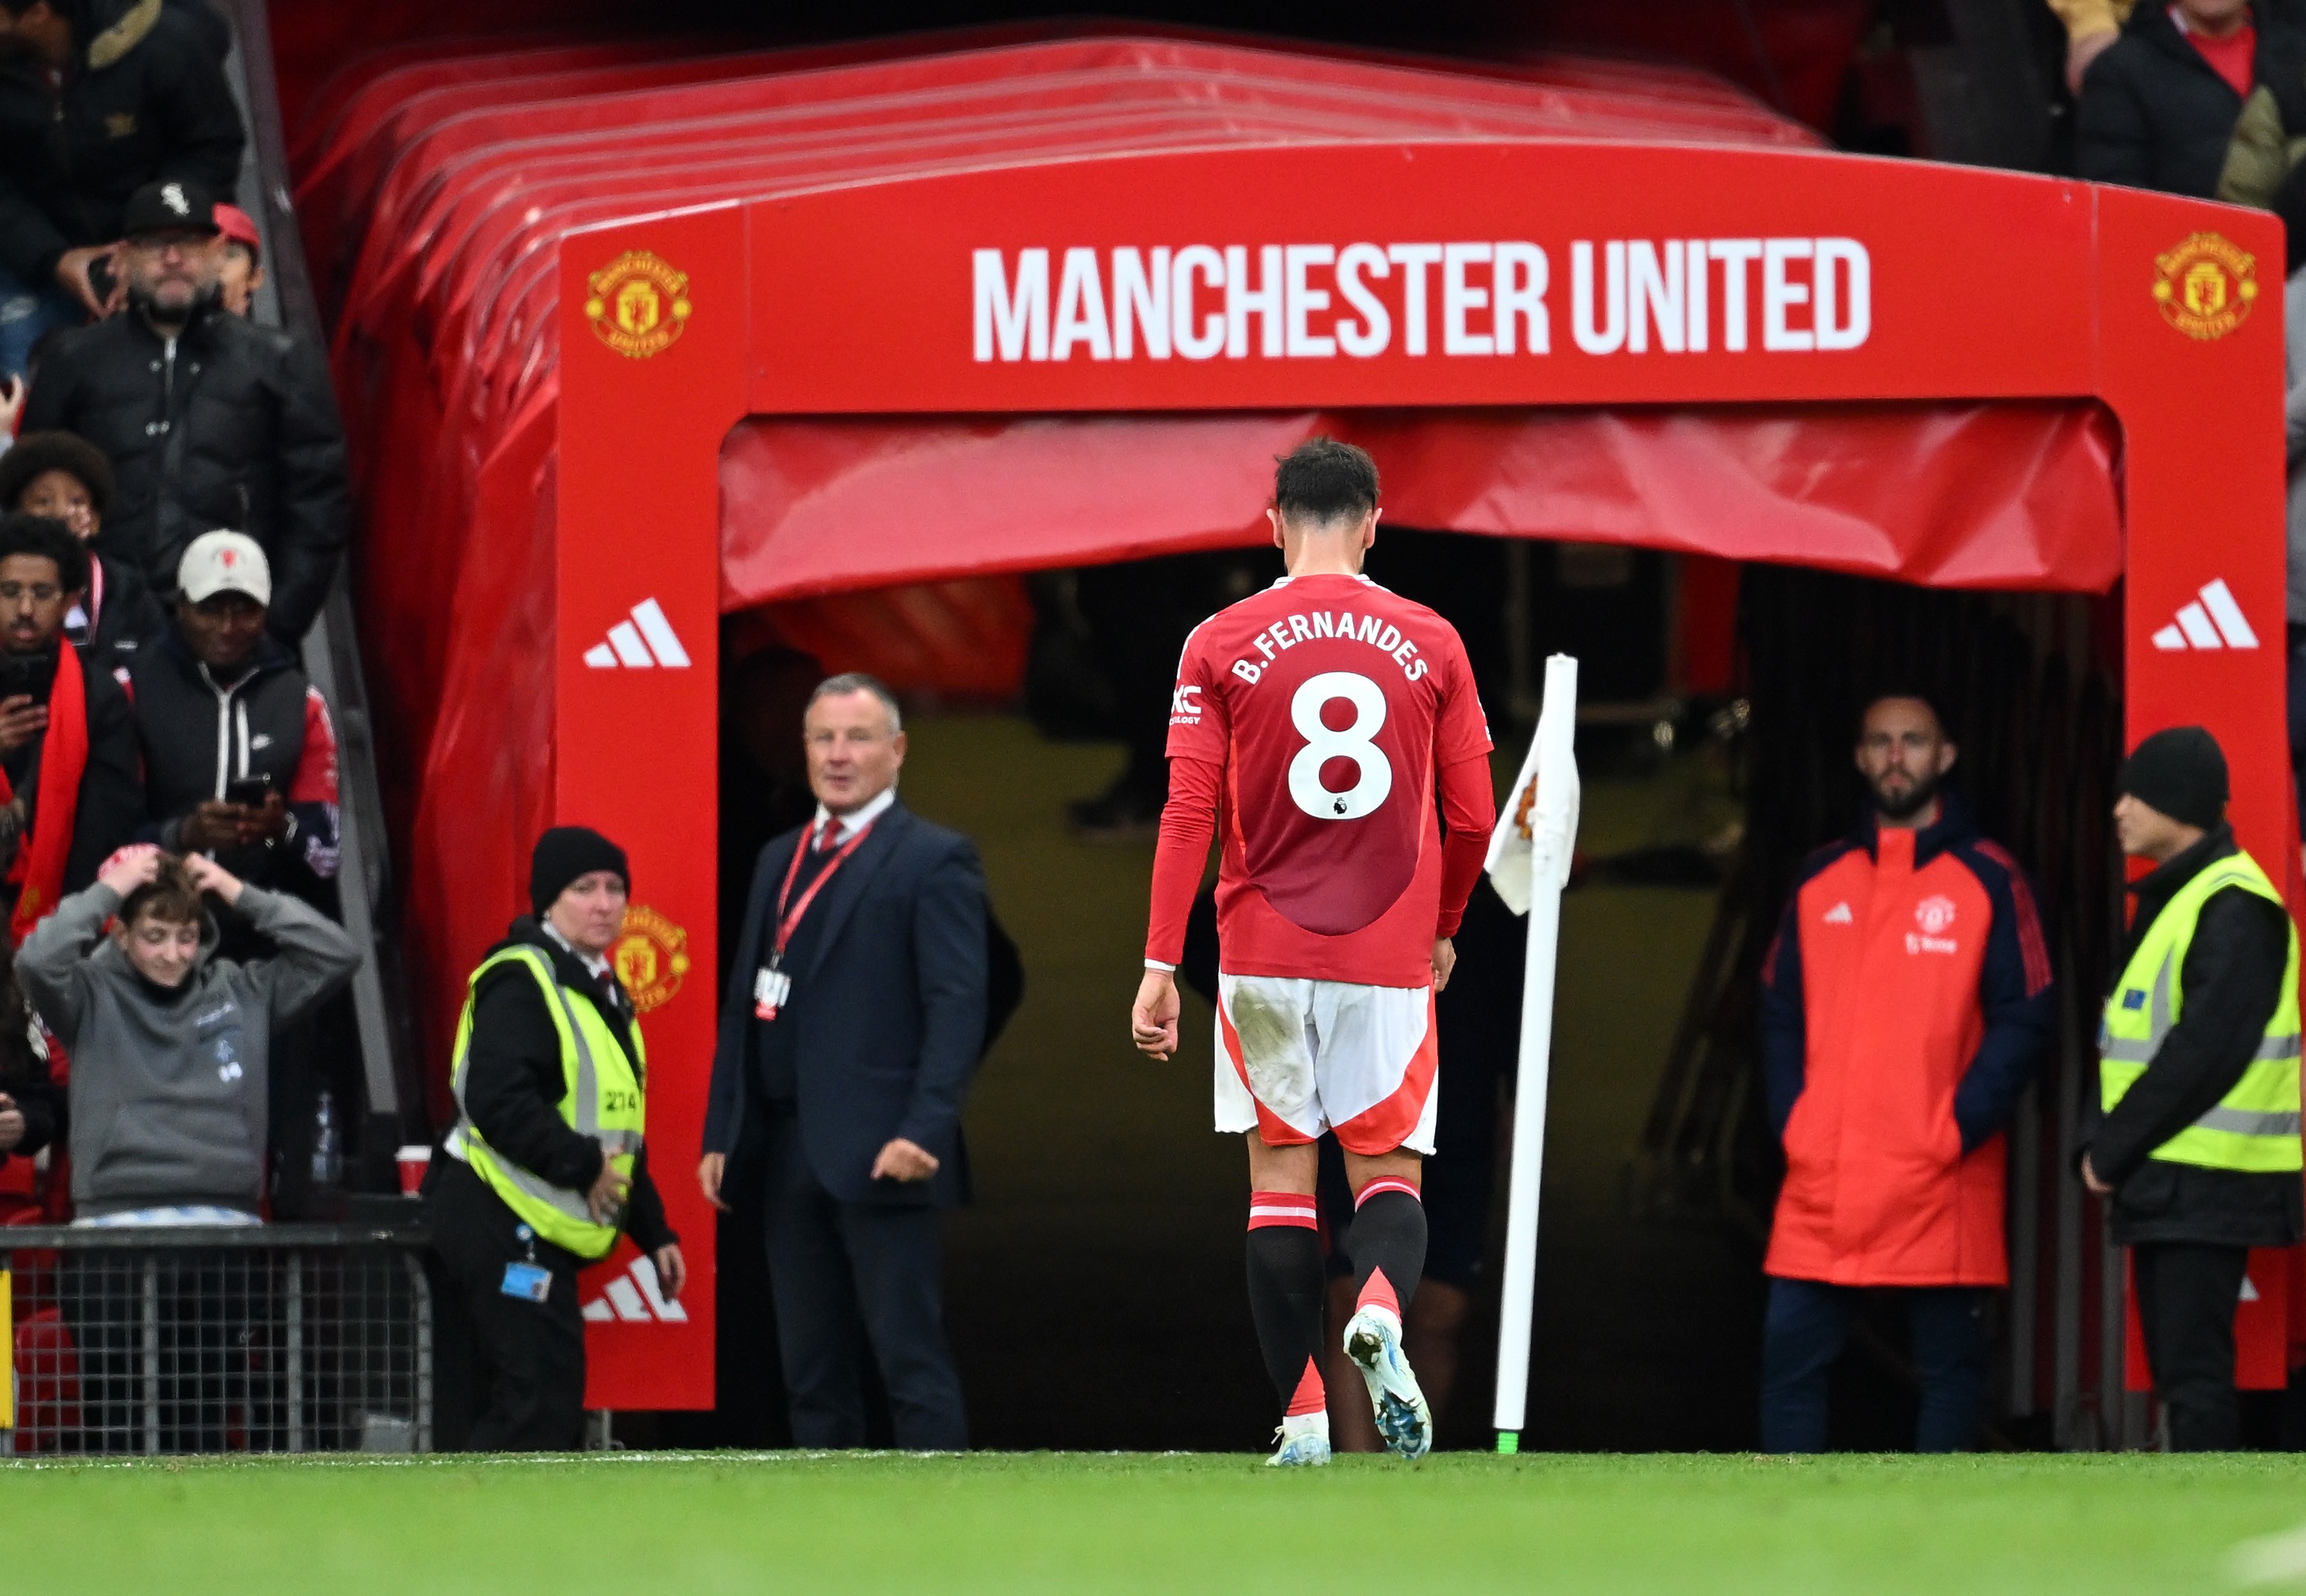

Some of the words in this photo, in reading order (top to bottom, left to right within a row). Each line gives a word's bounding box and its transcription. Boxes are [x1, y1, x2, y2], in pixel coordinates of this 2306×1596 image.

[972, 241, 1551, 362] MANCHESTER
[1571, 237, 1871, 355] UNITED
[1231, 610, 1428, 685] B.FERNANDES
[1288, 671, 1392, 820] 8
